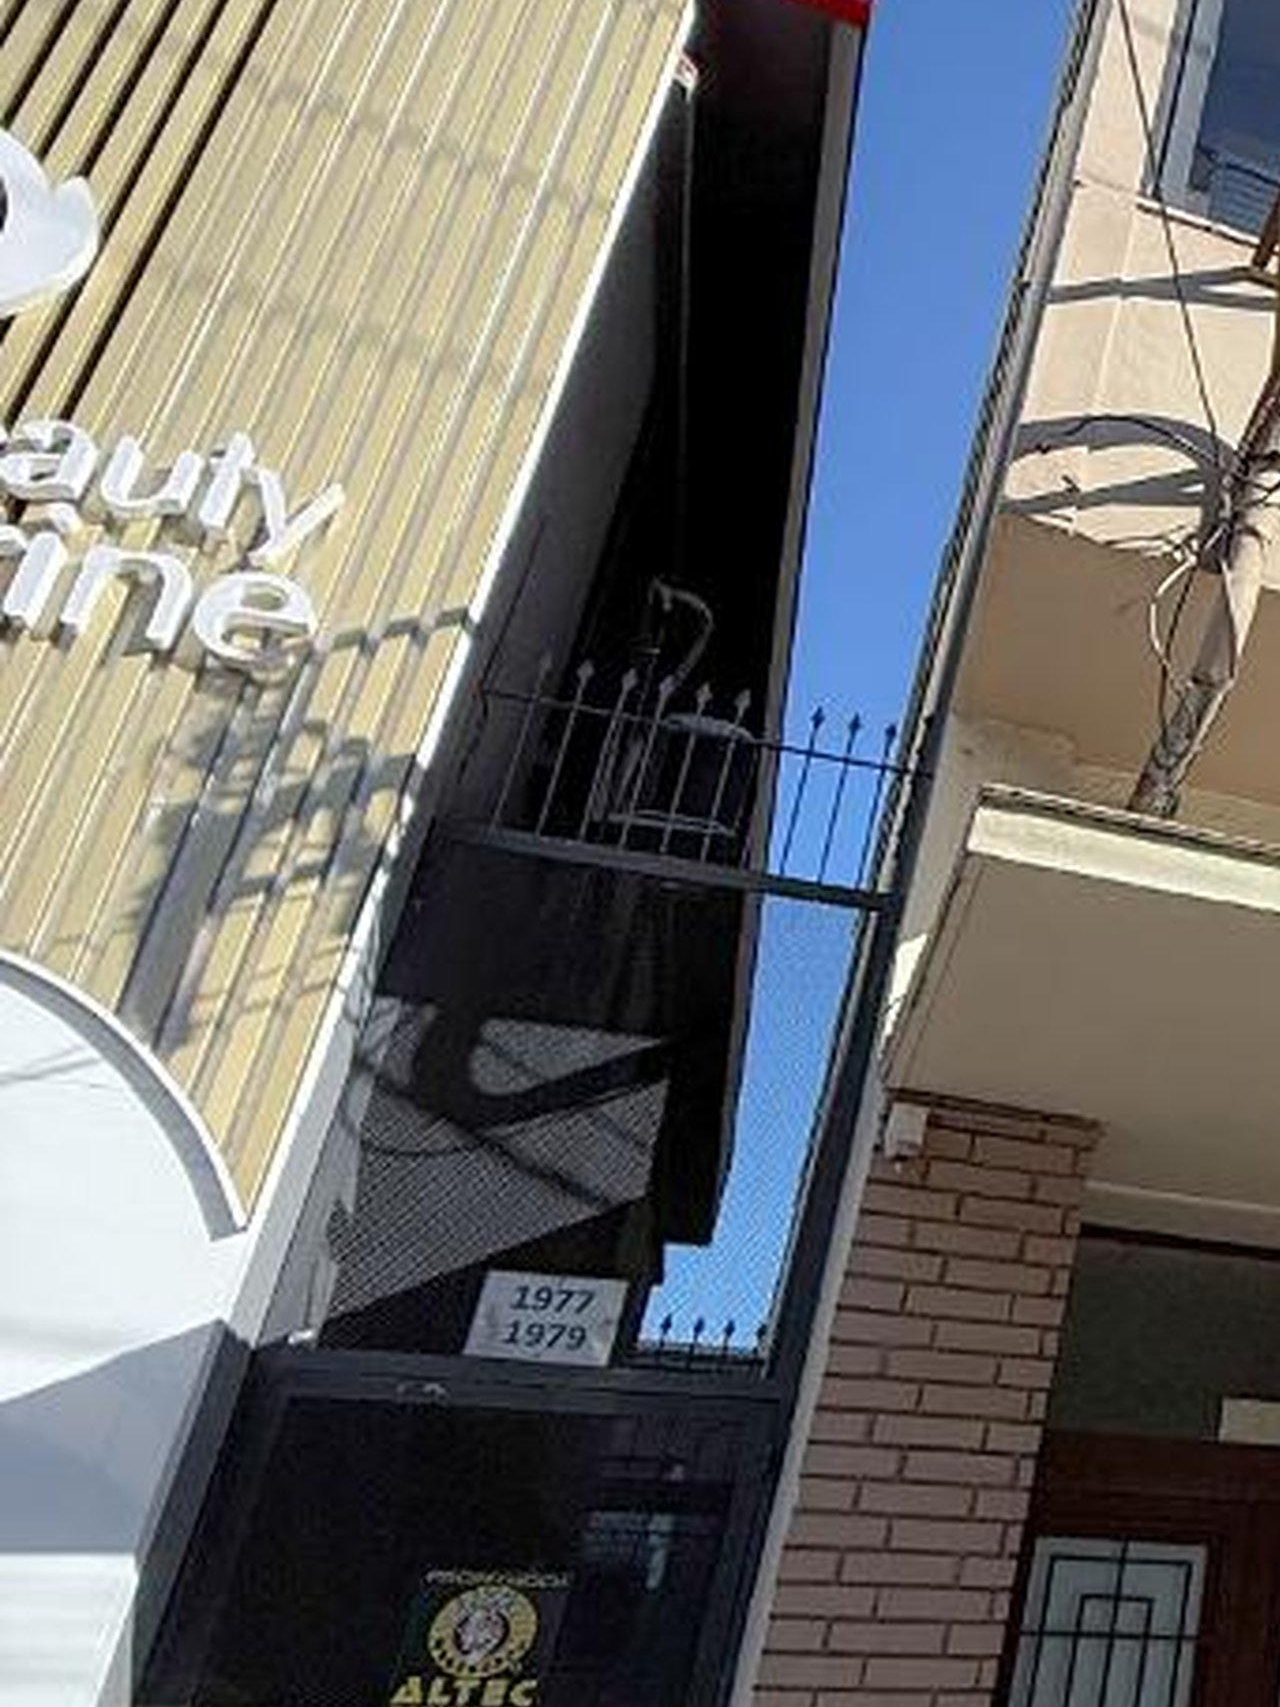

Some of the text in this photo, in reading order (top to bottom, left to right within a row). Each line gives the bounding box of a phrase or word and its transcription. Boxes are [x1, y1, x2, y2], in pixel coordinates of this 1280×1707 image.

[0, 419, 345, 571] auty
[0, 502, 318, 666] ine
[510, 1285, 596, 1314] 1977
[502, 1319, 587, 1350] 1979
[389, 1675, 539, 1707] ALTEC
